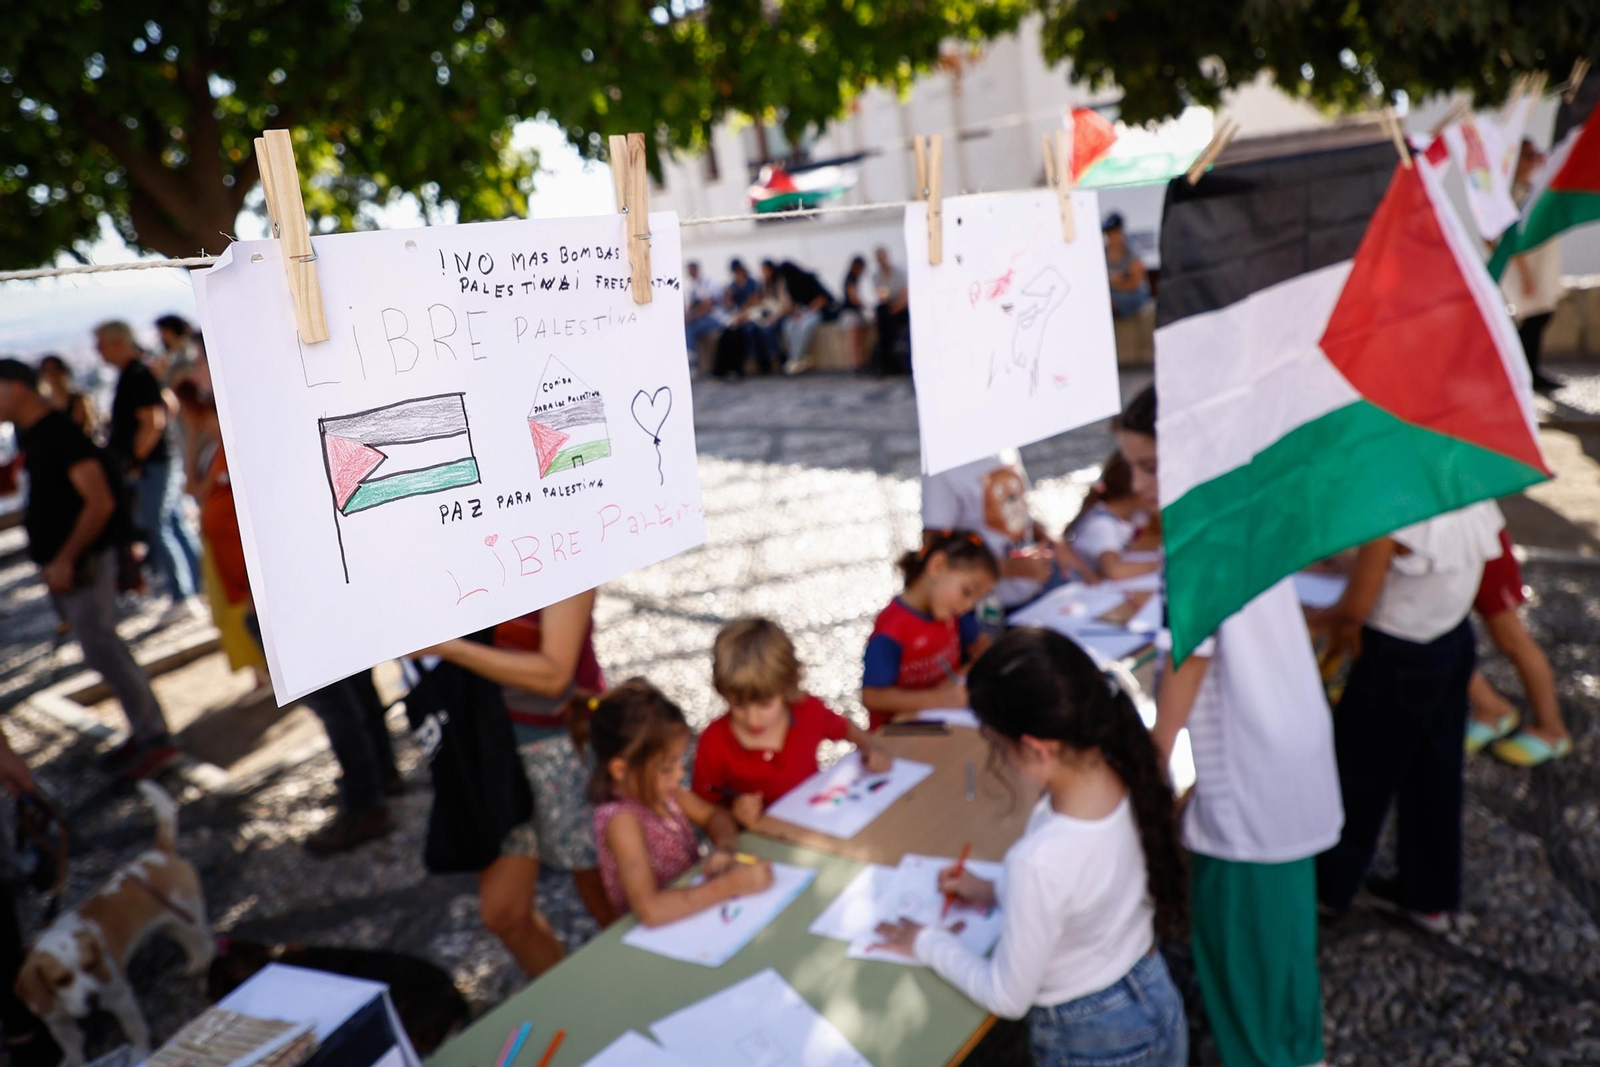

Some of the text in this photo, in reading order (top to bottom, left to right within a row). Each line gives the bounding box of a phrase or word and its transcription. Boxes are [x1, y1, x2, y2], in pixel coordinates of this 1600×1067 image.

[511, 251, 549, 271] MAS
[534, 402, 554, 414] PARA
[439, 498, 484, 525] PAZ
[496, 491, 533, 509] PARA
